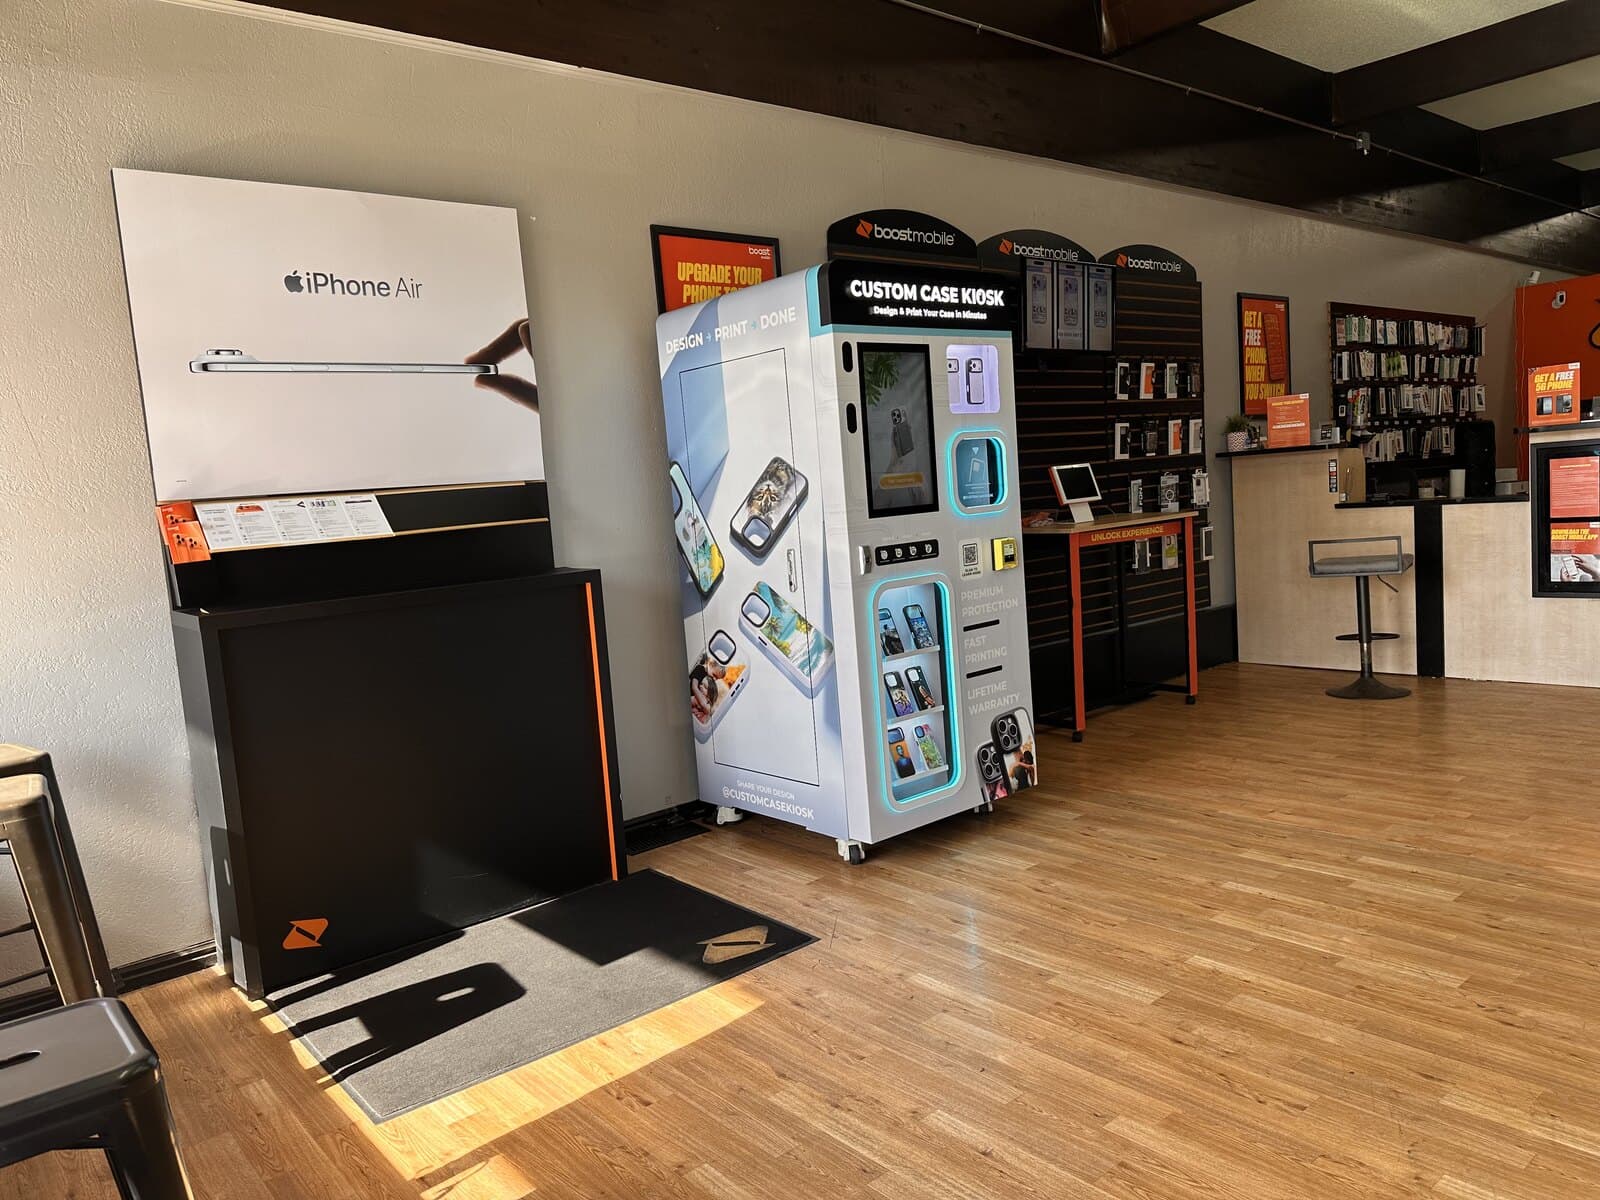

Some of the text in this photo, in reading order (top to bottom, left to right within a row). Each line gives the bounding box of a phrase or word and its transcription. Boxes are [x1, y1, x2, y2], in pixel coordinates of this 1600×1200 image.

[874, 223, 954, 246] boostmobile
[748, 246, 771, 256] boost
[1013, 242, 1079, 262] boostmobile
[677, 261, 762, 285] UPGRADE YOUR
[1128, 256, 1182, 273] boostmobile
[306, 272, 422, 298] iPhone Air
[683, 284, 722, 304] PHONE
[850, 279, 1005, 307] CUSTOM CASE KIOSK
[873, 305, 988, 320] Design & Print Your Case in Minutes
[1244, 310, 1262, 328] GET A
[666, 306, 797, 354] DESIGN PRINT DONE
[1244, 328, 1261, 346] FREE
[1245, 347, 1267, 364] PHONE
[1245, 365, 1266, 382] WHEN
[1534, 370, 1575, 383] GET A FREE
[1245, 383, 1286, 400] YOU SWITCH
[1535, 380, 1574, 392] 5G PHONE
[1091, 525, 1165, 542] UNLOCK EXPERIENCE
[961, 584, 1004, 602] PREMIUM
[962, 598, 1019, 617] PROTECTION
[964, 635, 987, 649] FAST
[965, 646, 1008, 665] PRINTING
[968, 680, 1008, 700] LIFETIME
[968, 692, 1021, 716] WARRANTY
[737, 780, 795, 801] SHARE YOUR DESIGN
[722, 786, 815, 820] @CUSTOMCASEKIOSK
